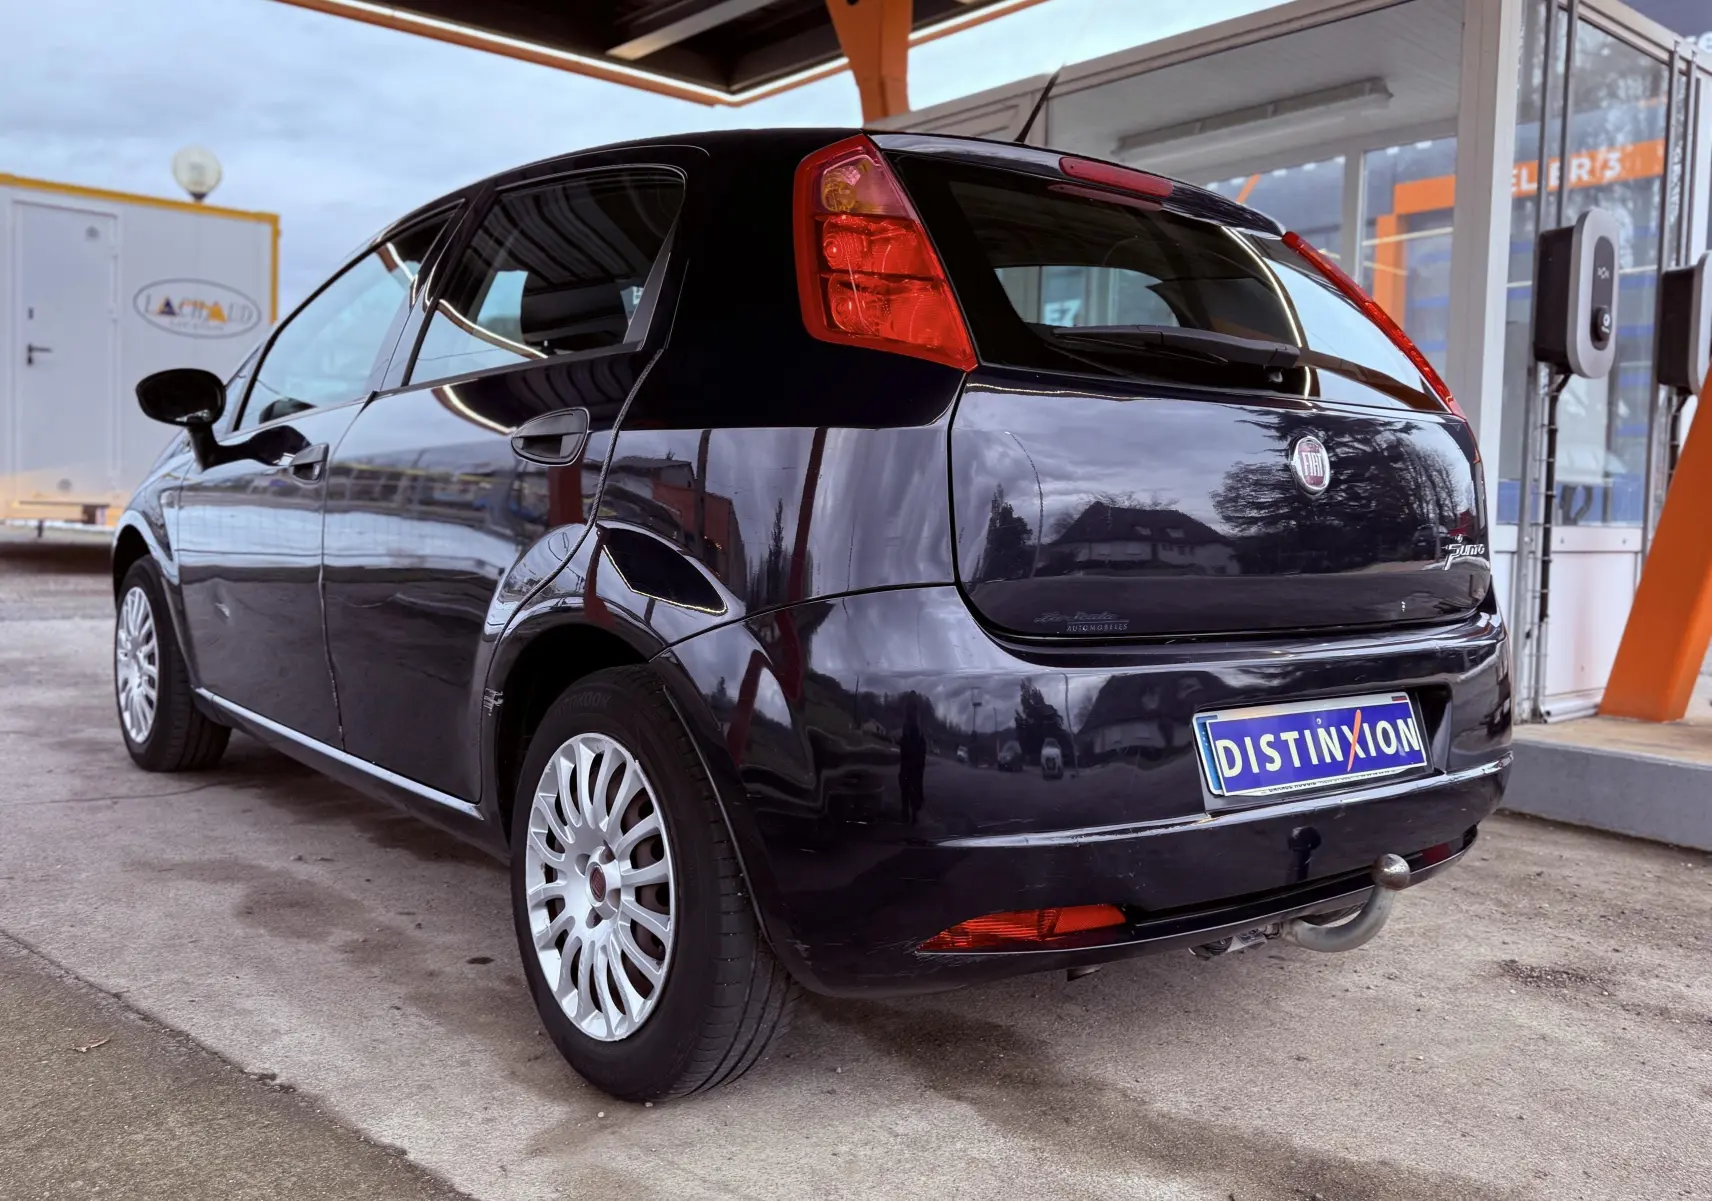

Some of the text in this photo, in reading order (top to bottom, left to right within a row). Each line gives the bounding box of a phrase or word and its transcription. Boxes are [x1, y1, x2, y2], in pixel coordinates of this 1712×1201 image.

[1302, 452, 1324, 477] FIAT
[1066, 623, 1128, 632] AUTOMOBILES
[1215, 709, 1421, 778] DISTINXION
